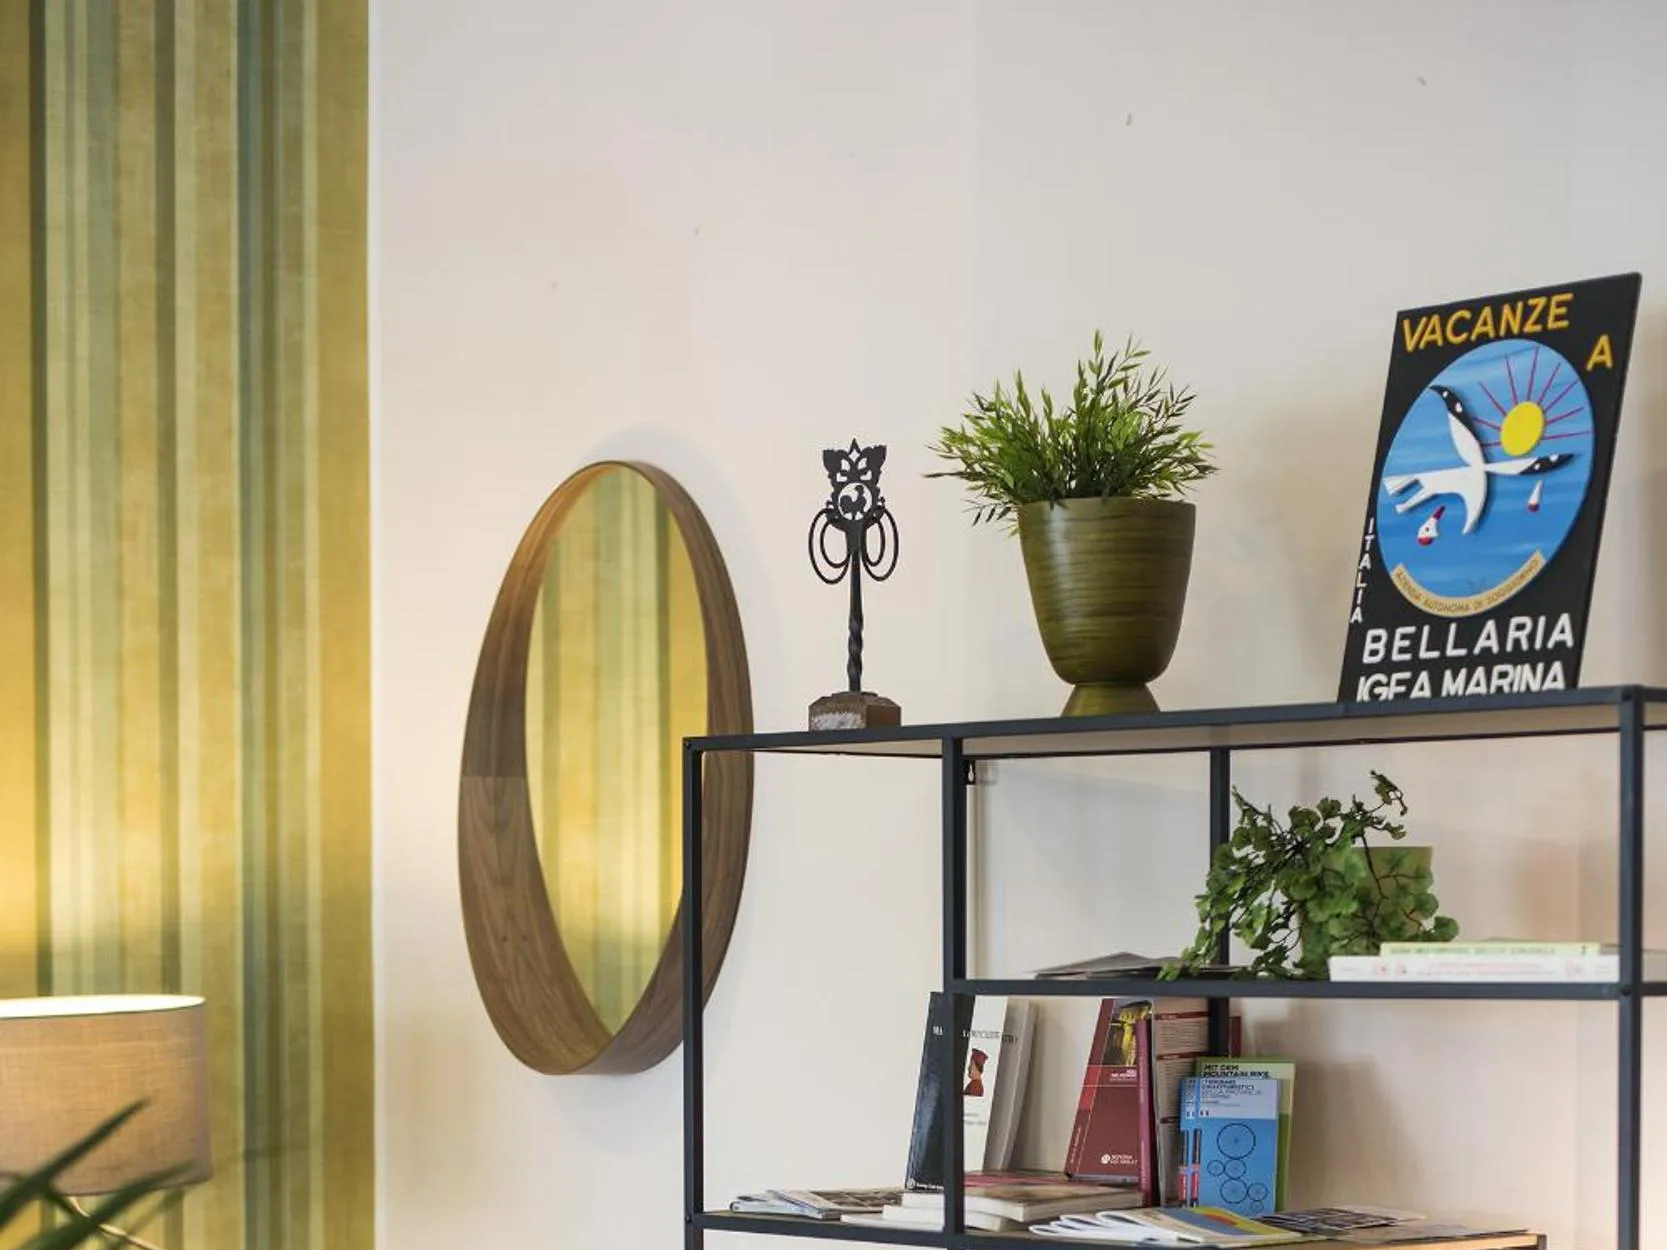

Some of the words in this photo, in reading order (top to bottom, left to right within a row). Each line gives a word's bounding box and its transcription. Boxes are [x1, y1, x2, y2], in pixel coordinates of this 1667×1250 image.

[1403, 292, 1573, 352] VACANZE
[1586, 334, 1613, 371] A
[1350, 517, 1375, 623] ITALIA
[1362, 613, 1574, 664] BELLARIA
[1441, 660, 1565, 698] MARINA
